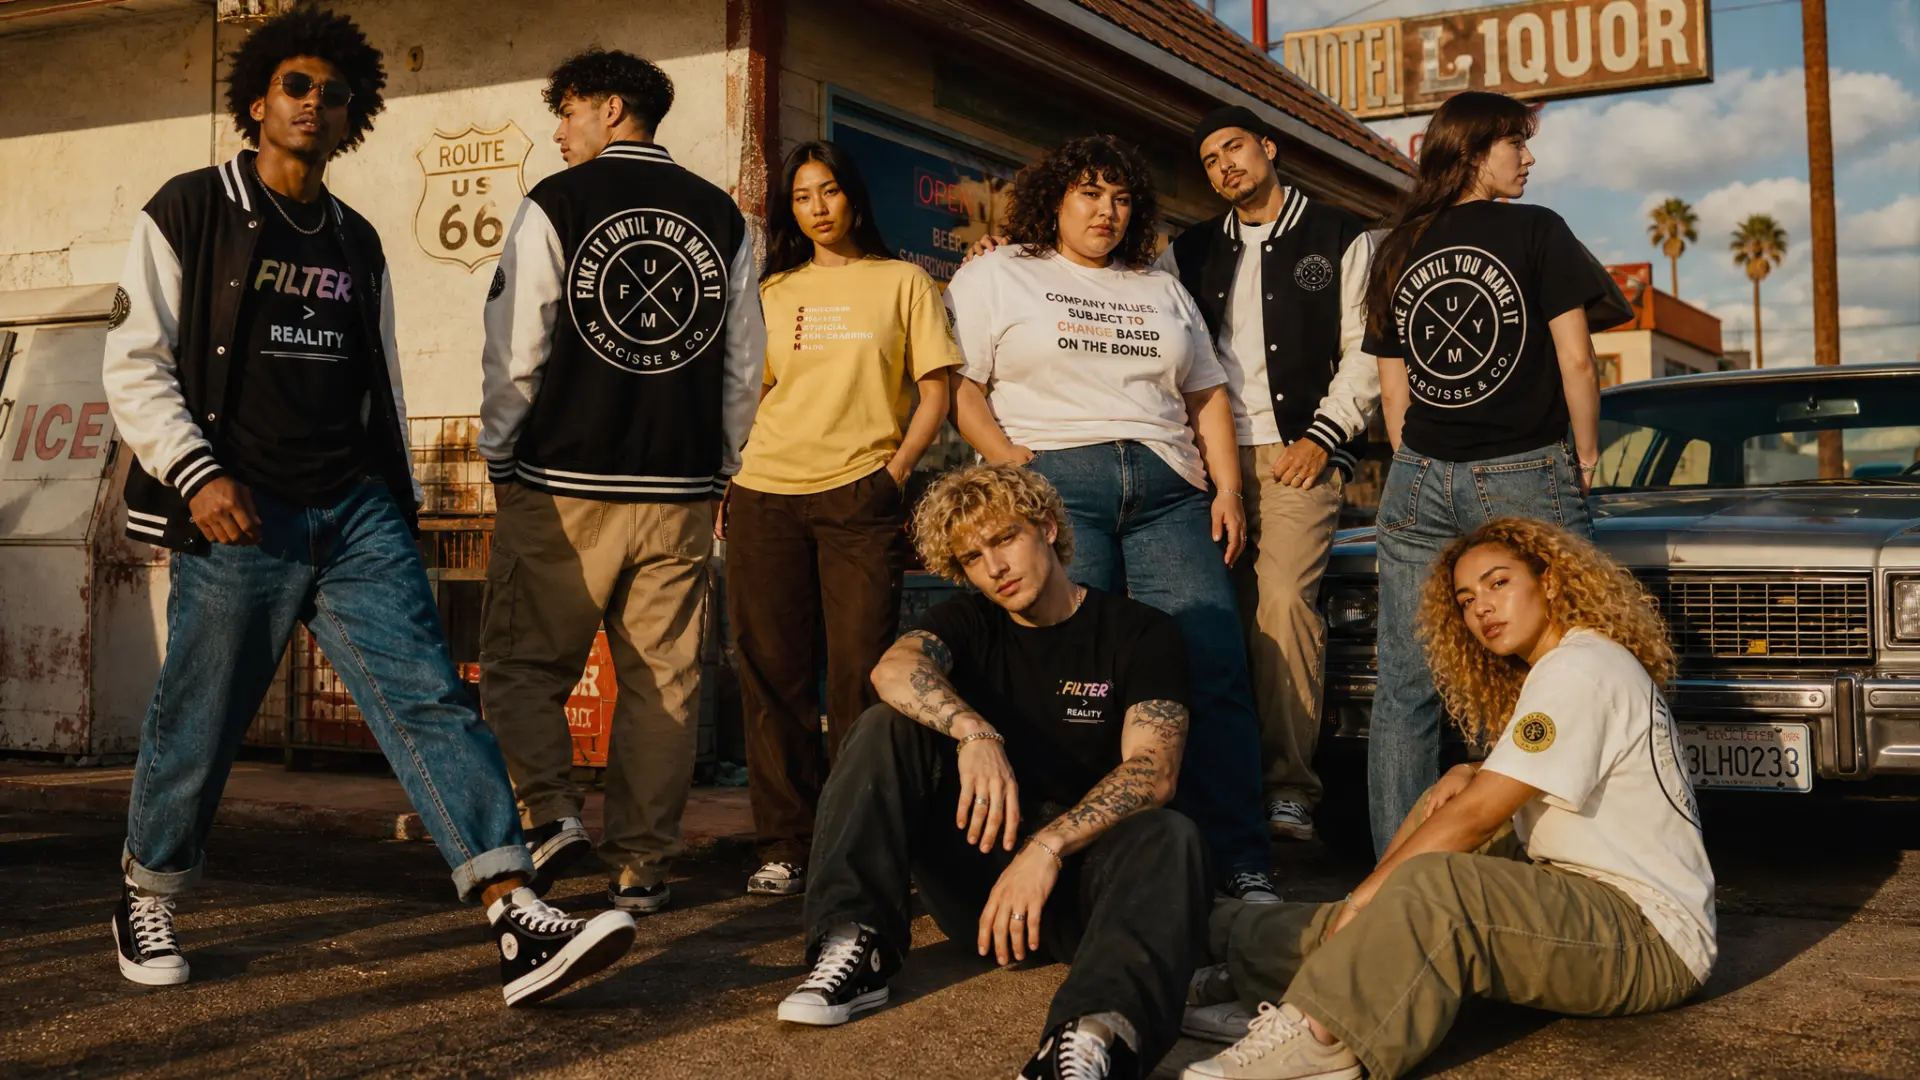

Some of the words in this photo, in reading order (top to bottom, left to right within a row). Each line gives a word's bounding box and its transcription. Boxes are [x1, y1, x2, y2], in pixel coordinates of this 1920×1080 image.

[1288, 25, 1403, 110] MOTEL
[440, 140, 505, 167] ROUTE
[452, 177, 492, 197] US
[920, 175, 973, 216] OPEN
[439, 200, 503, 251] 66
[932, 227, 965, 254] BEER
[576, 257, 600, 299] FAKE
[589, 237, 609, 259] IT
[605, 216, 650, 245] UNTIL
[656, 217, 687, 243] YOU
[684, 236, 719, 281] MAKE
[703, 285, 721, 300] IT
[644, 259, 657, 275] U
[1454, 254, 1482, 276] YOU
[254, 259, 353, 302] FILTER
[1410, 257, 1450, 291] UNTIL
[620, 284, 630, 299] F
[672, 287, 684, 302] Y
[1399, 287, 1414, 306] IT
[1481, 264, 1515, 308] MAKE
[1046, 292, 1105, 310] COMPANY
[1109, 302, 1158, 314] VALUES:
[1446, 296, 1458, 312] U
[641, 312, 656, 328] M
[1068, 308, 1123, 324] SUBJECT
[1126, 316, 1144, 326] TO
[1395, 306, 1408, 344] AKE
[1503, 310, 1519, 325] IT
[271, 325, 344, 348] REALITY
[1057, 321, 1112, 338] CHANGE
[1116, 329, 1160, 341] BASED
[1425, 325, 1435, 340] F
[1472, 318, 1484, 334] Y
[586, 320, 663, 366] NARCISSE
[670, 350, 681, 361] &
[685, 328, 709, 350] CO.
[1058, 337, 1078, 350] ON
[1082, 339, 1107, 353] THE
[1111, 343, 1161, 358] BONUS.
[1448, 348, 1462, 363] M
[1406, 364, 1473, 400] NARCISSE
[1478, 380, 1488, 391] &
[1491, 353, 1511, 378] CO.
[12, 402, 109, 461] ICE
[1062, 681, 1109, 698] FILTER
[1067, 708, 1102, 718] REALITY
